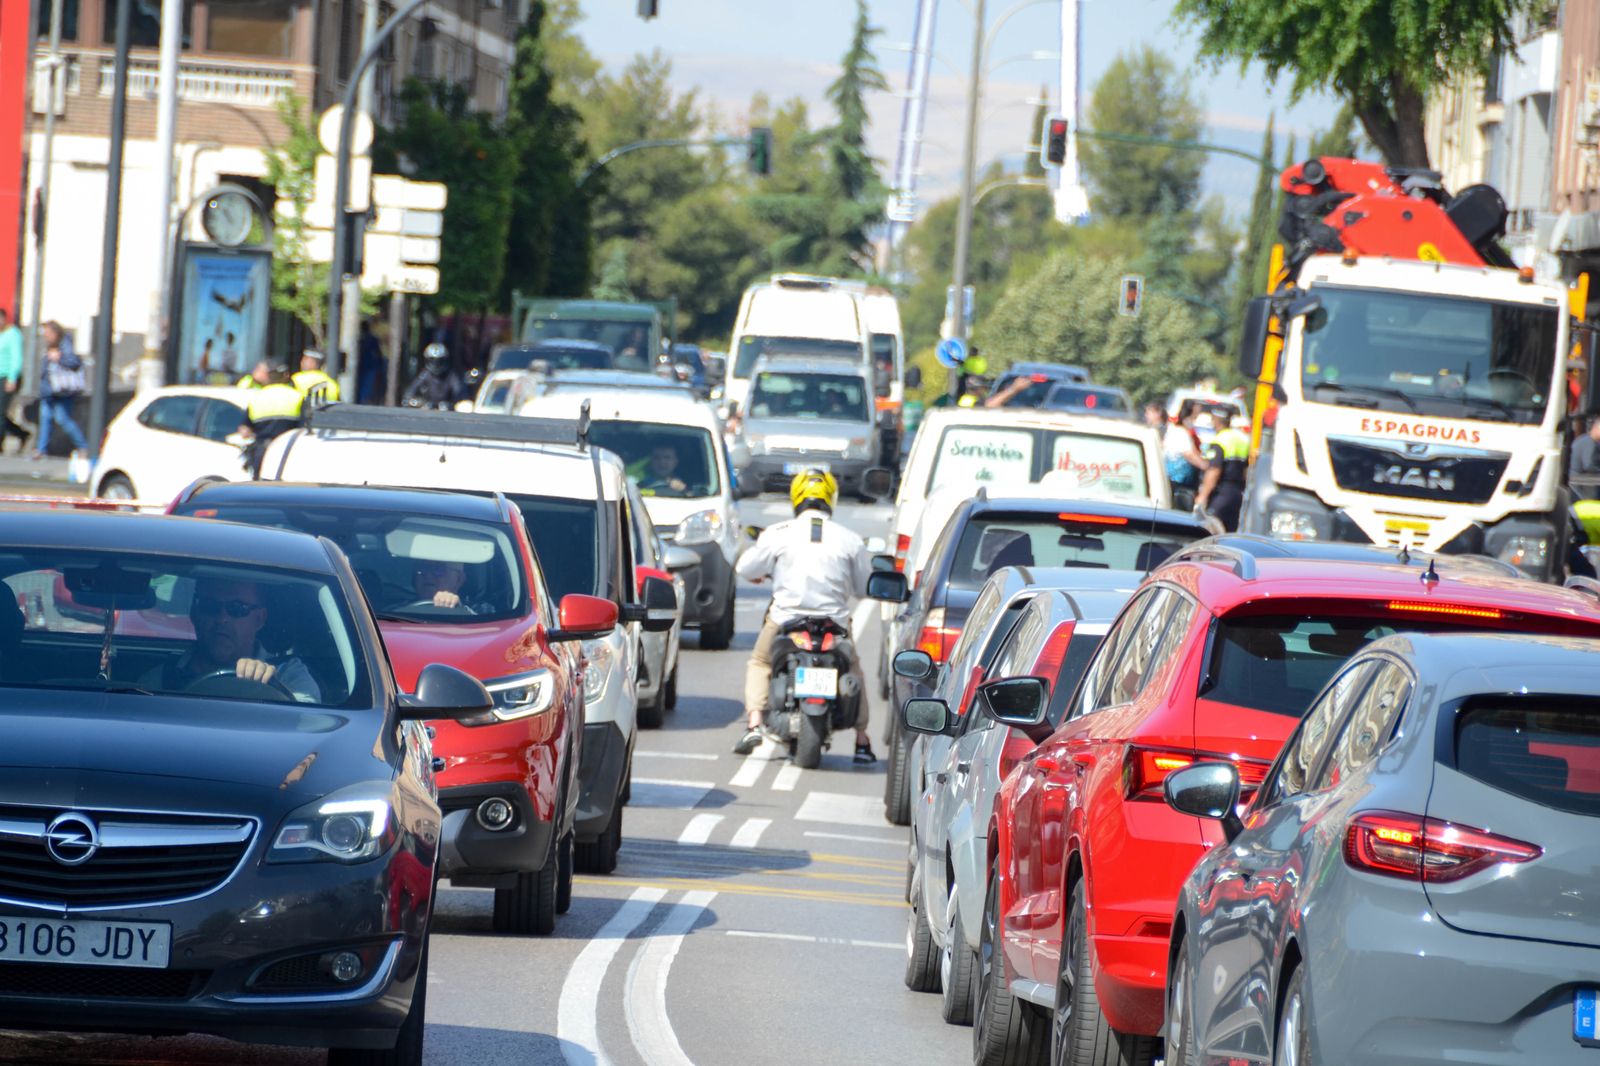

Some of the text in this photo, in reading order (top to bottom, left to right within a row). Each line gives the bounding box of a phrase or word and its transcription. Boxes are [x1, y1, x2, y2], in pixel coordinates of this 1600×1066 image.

[1361, 418, 1480, 443] ESPAGRUAS
[950, 440, 1024, 462] Servicios
[1373, 463, 1455, 490] MAN
[90, 926, 156, 961] JDY
[1582, 1016, 1591, 1028] E
